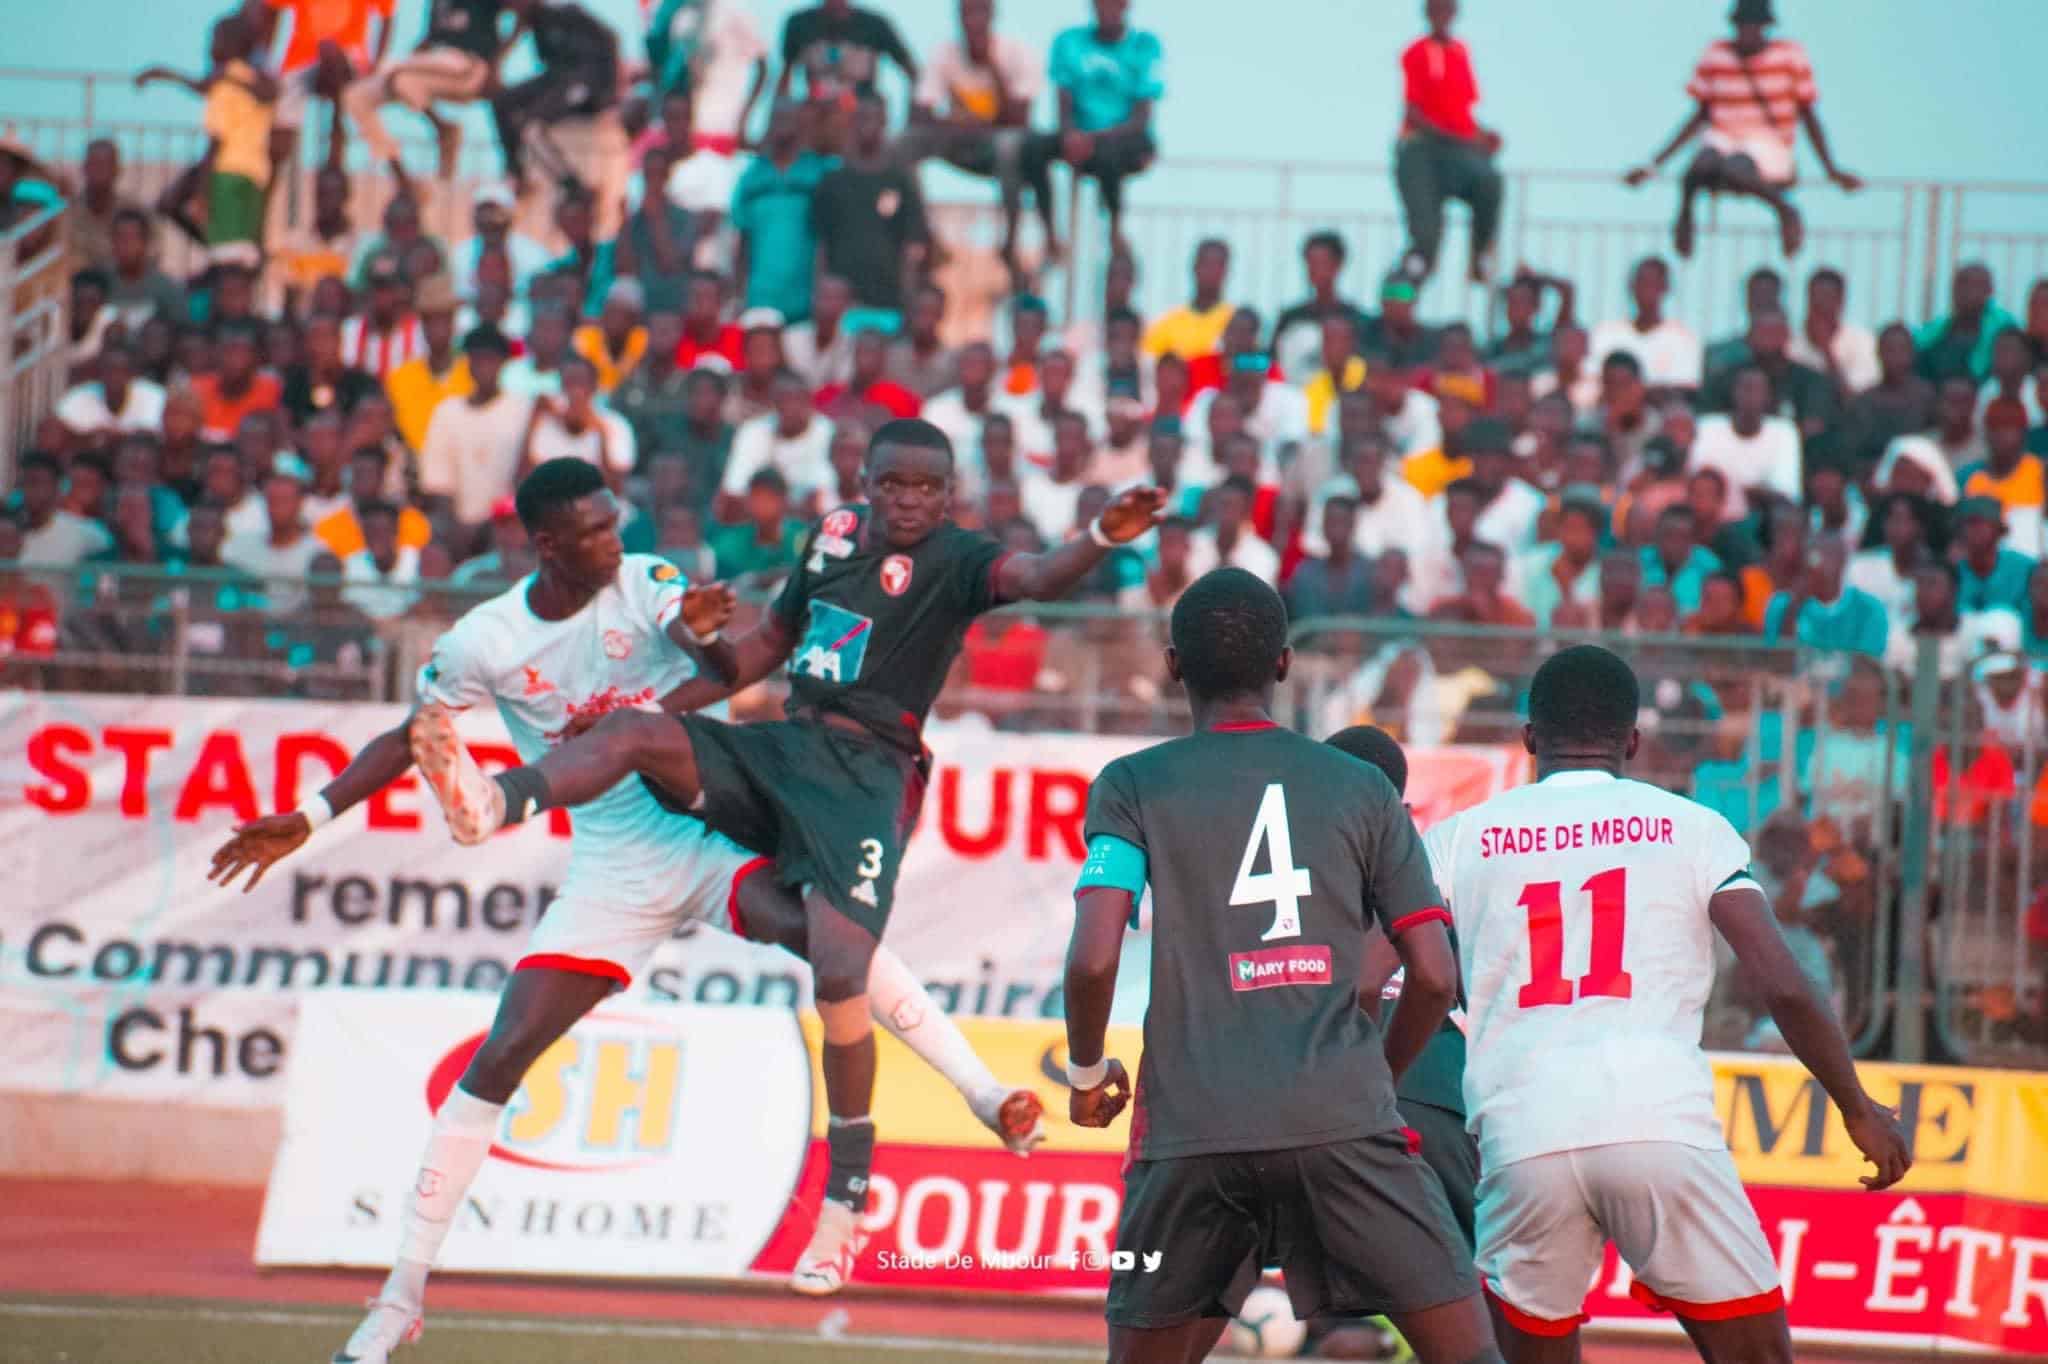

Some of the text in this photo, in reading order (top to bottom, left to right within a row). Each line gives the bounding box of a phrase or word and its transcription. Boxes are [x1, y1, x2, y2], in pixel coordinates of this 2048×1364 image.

[860, 839, 884, 878] 3
[1229, 783, 1312, 941] 4
[1481, 816, 1673, 857] STADE DE MBOUR
[291, 868, 558, 932] remer
[1517, 867, 1632, 1009] 11
[648, 966, 801, 1004] son
[1239, 959, 1326, 982] MARY FOOD
[109, 1008, 284, 1077] Che
[348, 1190, 729, 1242] SNHOME
